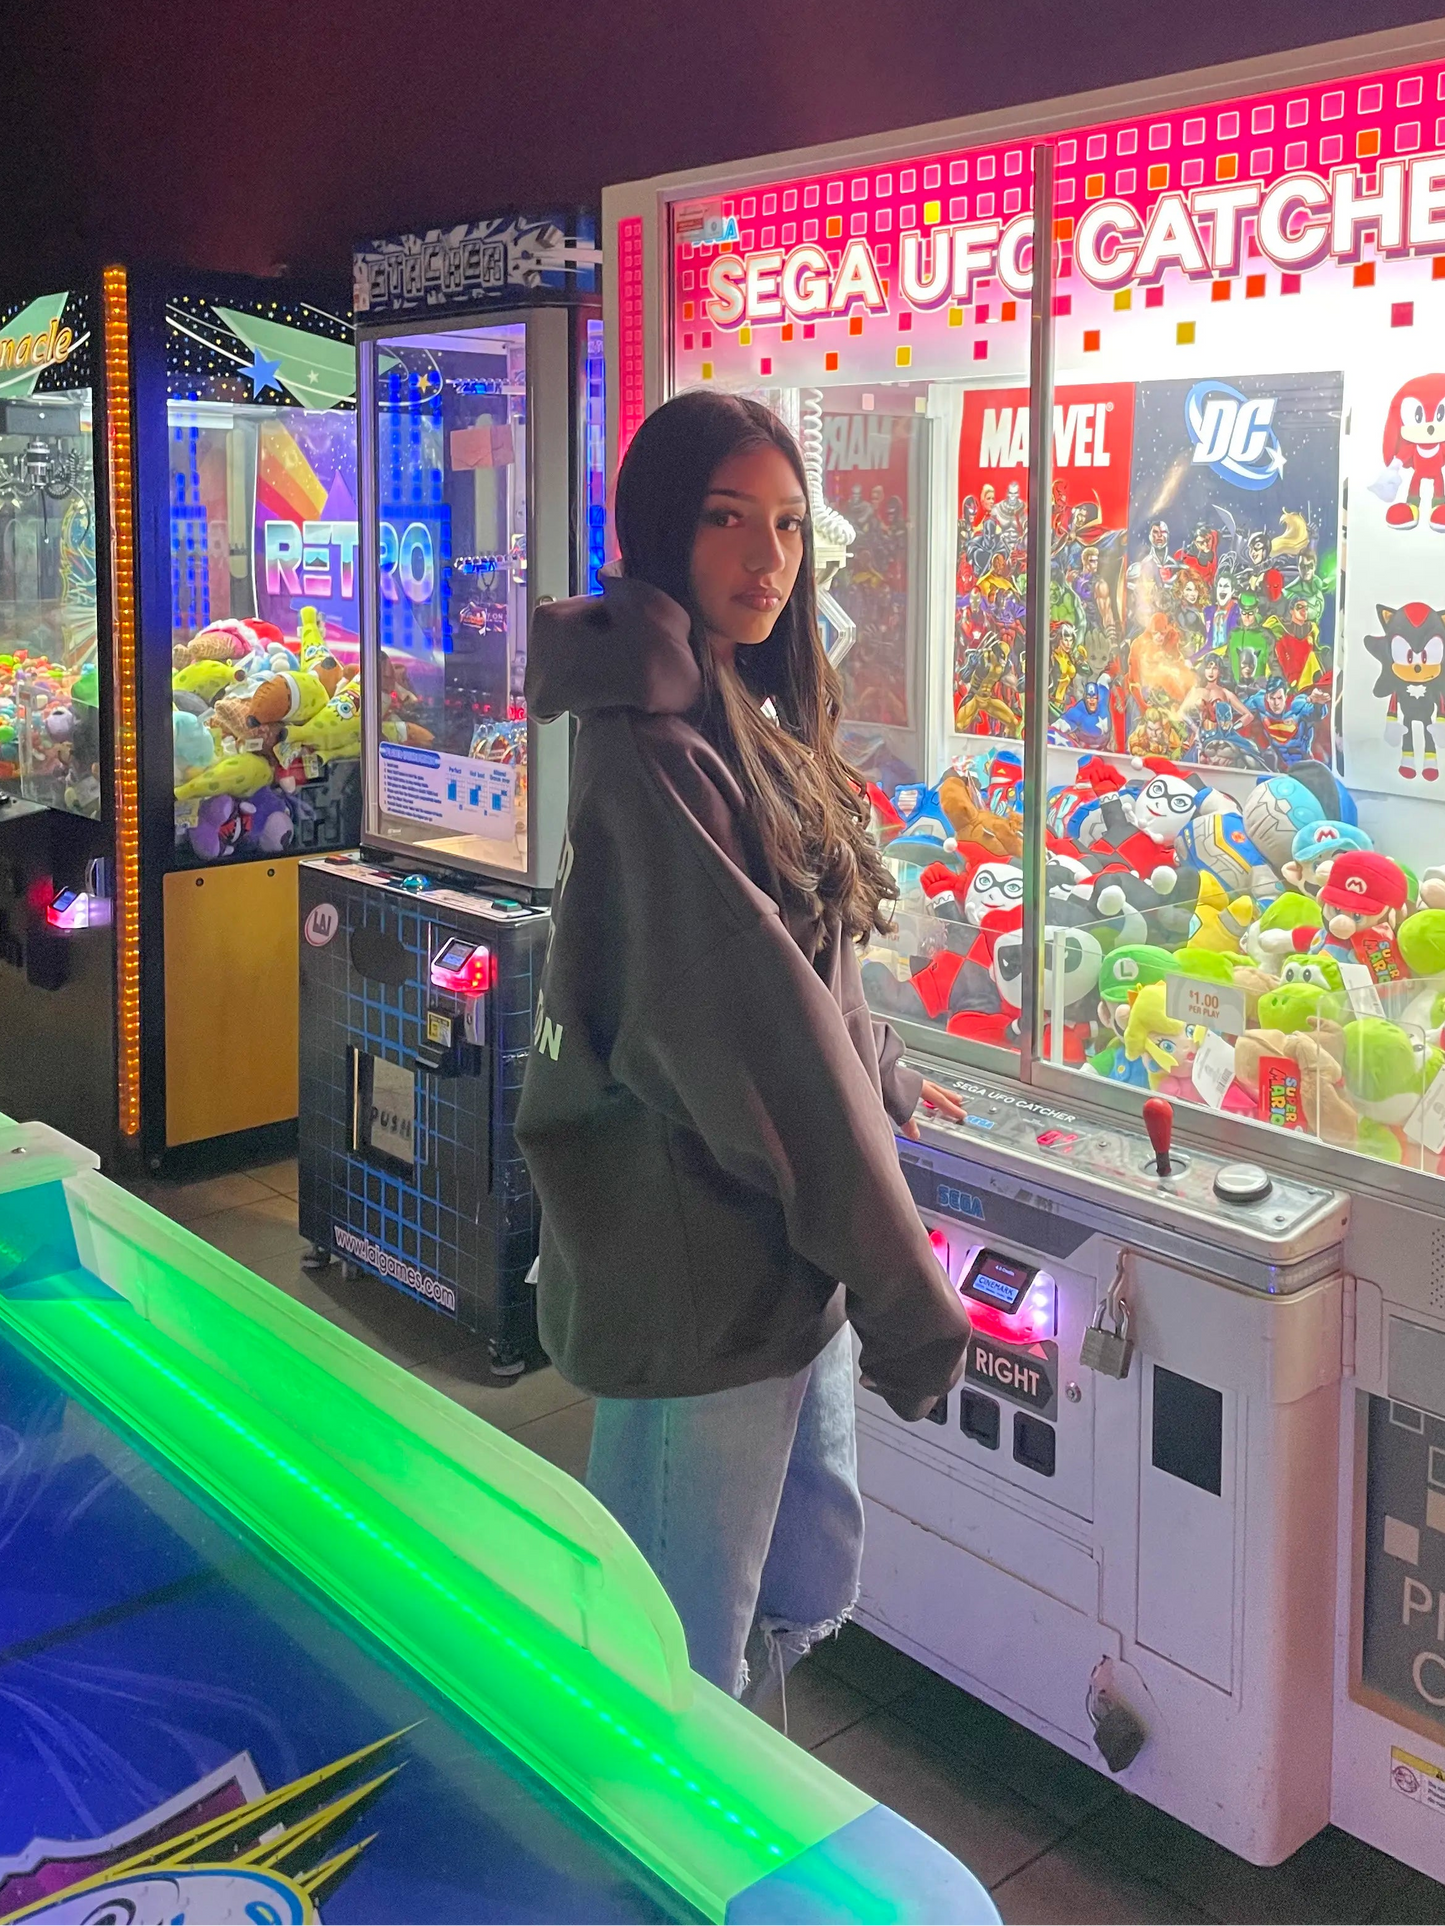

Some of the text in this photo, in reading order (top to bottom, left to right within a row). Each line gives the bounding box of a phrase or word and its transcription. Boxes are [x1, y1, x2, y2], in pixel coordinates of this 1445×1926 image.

[708, 238, 889, 332] SEGA
[1075, 153, 1445, 293] CATCHE
[366, 240, 506, 302] STACKER
[979, 403, 1110, 468] MAVEL
[1191, 397, 1278, 465] DC
[265, 520, 434, 603] RETRO
[1120, 961, 1133, 977] L
[1378, 940, 1400, 979] SUPER
[1188, 1004, 1220, 1018] PER PLAY
[1189, 990, 1219, 1009] $1.00
[953, 1080, 986, 1096] SEGA
[987, 1091, 1016, 1104] UFO
[1015, 1100, 1077, 1123] CATCHER
[1268, 1067, 1286, 1127] MARIO
[1285, 1076, 1298, 1123] SUPER
[370, 1105, 412, 1138] PUSH
[937, 1183, 985, 1221] SEGA
[334, 1225, 456, 1311] www.laigames.com
[978, 1276, 1014, 1297] CINEMARK
[976, 1346, 1040, 1397] RIGHT
